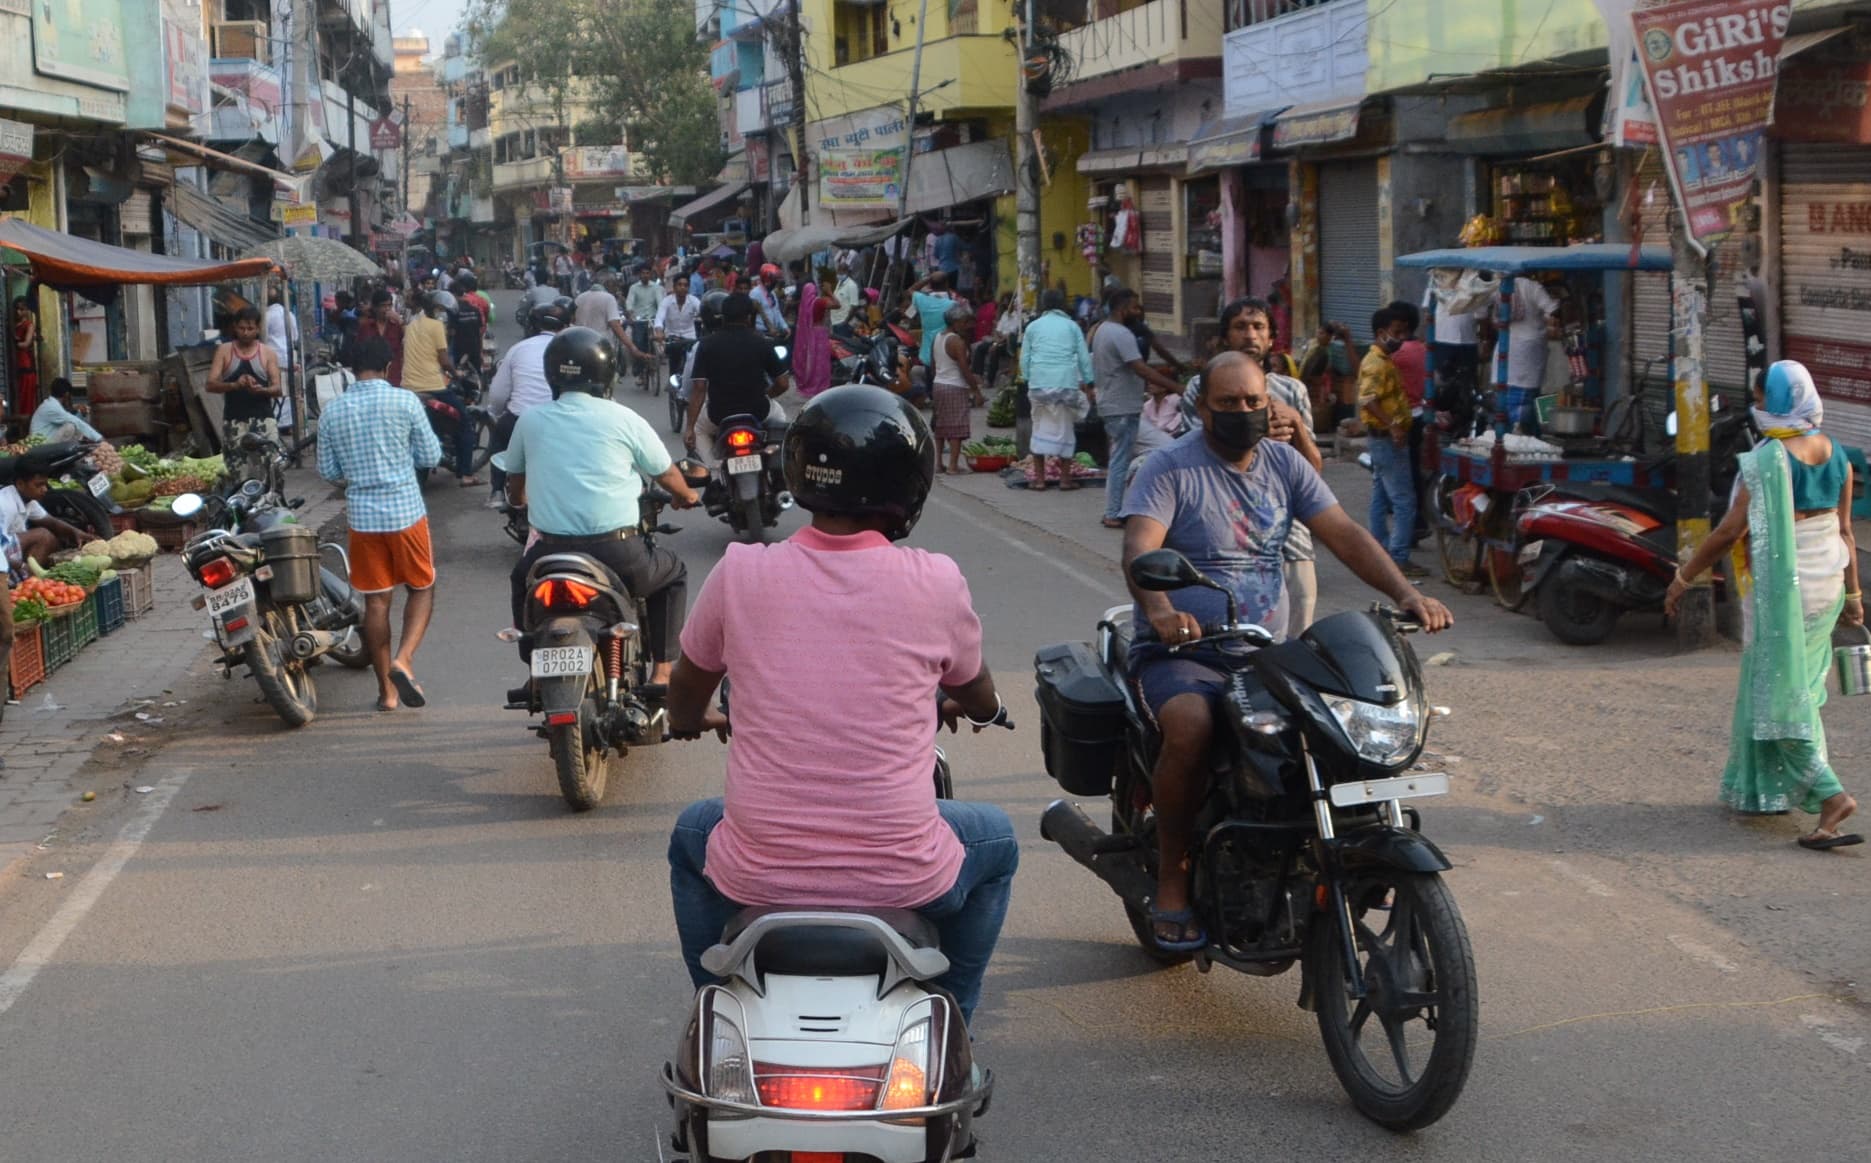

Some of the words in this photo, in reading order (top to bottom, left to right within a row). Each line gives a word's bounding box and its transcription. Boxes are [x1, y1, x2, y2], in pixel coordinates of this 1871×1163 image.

[1675, 4, 1792, 57] GiRi'S
[805, 464, 842, 484] STUDDS
[542, 648, 584, 662] BR02A
